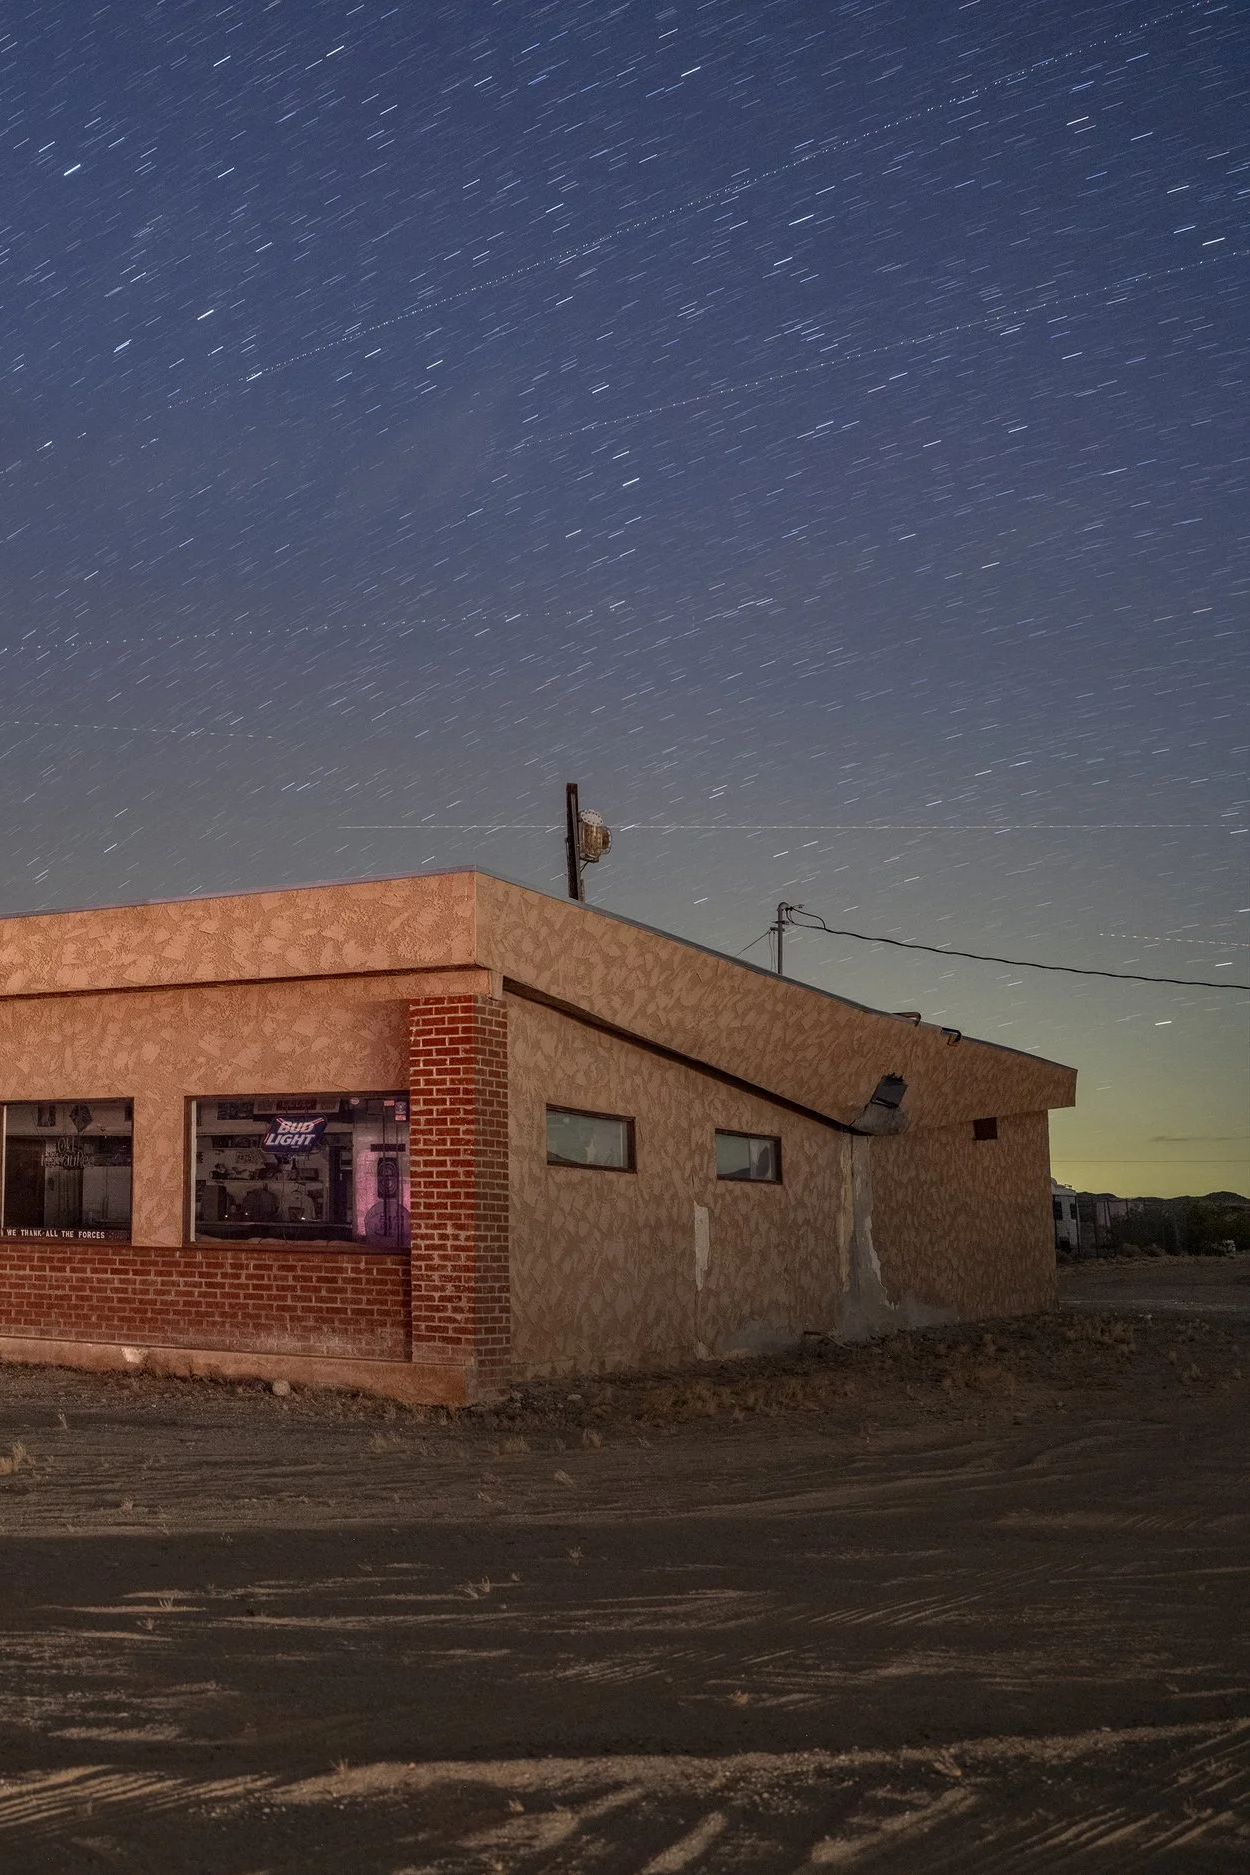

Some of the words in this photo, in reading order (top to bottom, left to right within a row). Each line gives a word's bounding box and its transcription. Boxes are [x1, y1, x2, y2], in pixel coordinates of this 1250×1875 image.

[277, 1121, 315, 1134] BUD
[265, 1134, 316, 1146] LIGHT
[6, 1229, 17, 1237] WE
[20, 1229, 42, 1237] THANK
[45, 1229, 58, 1238] ALL
[61, 1230, 74, 1238] THE
[78, 1231, 106, 1239] FORCES
